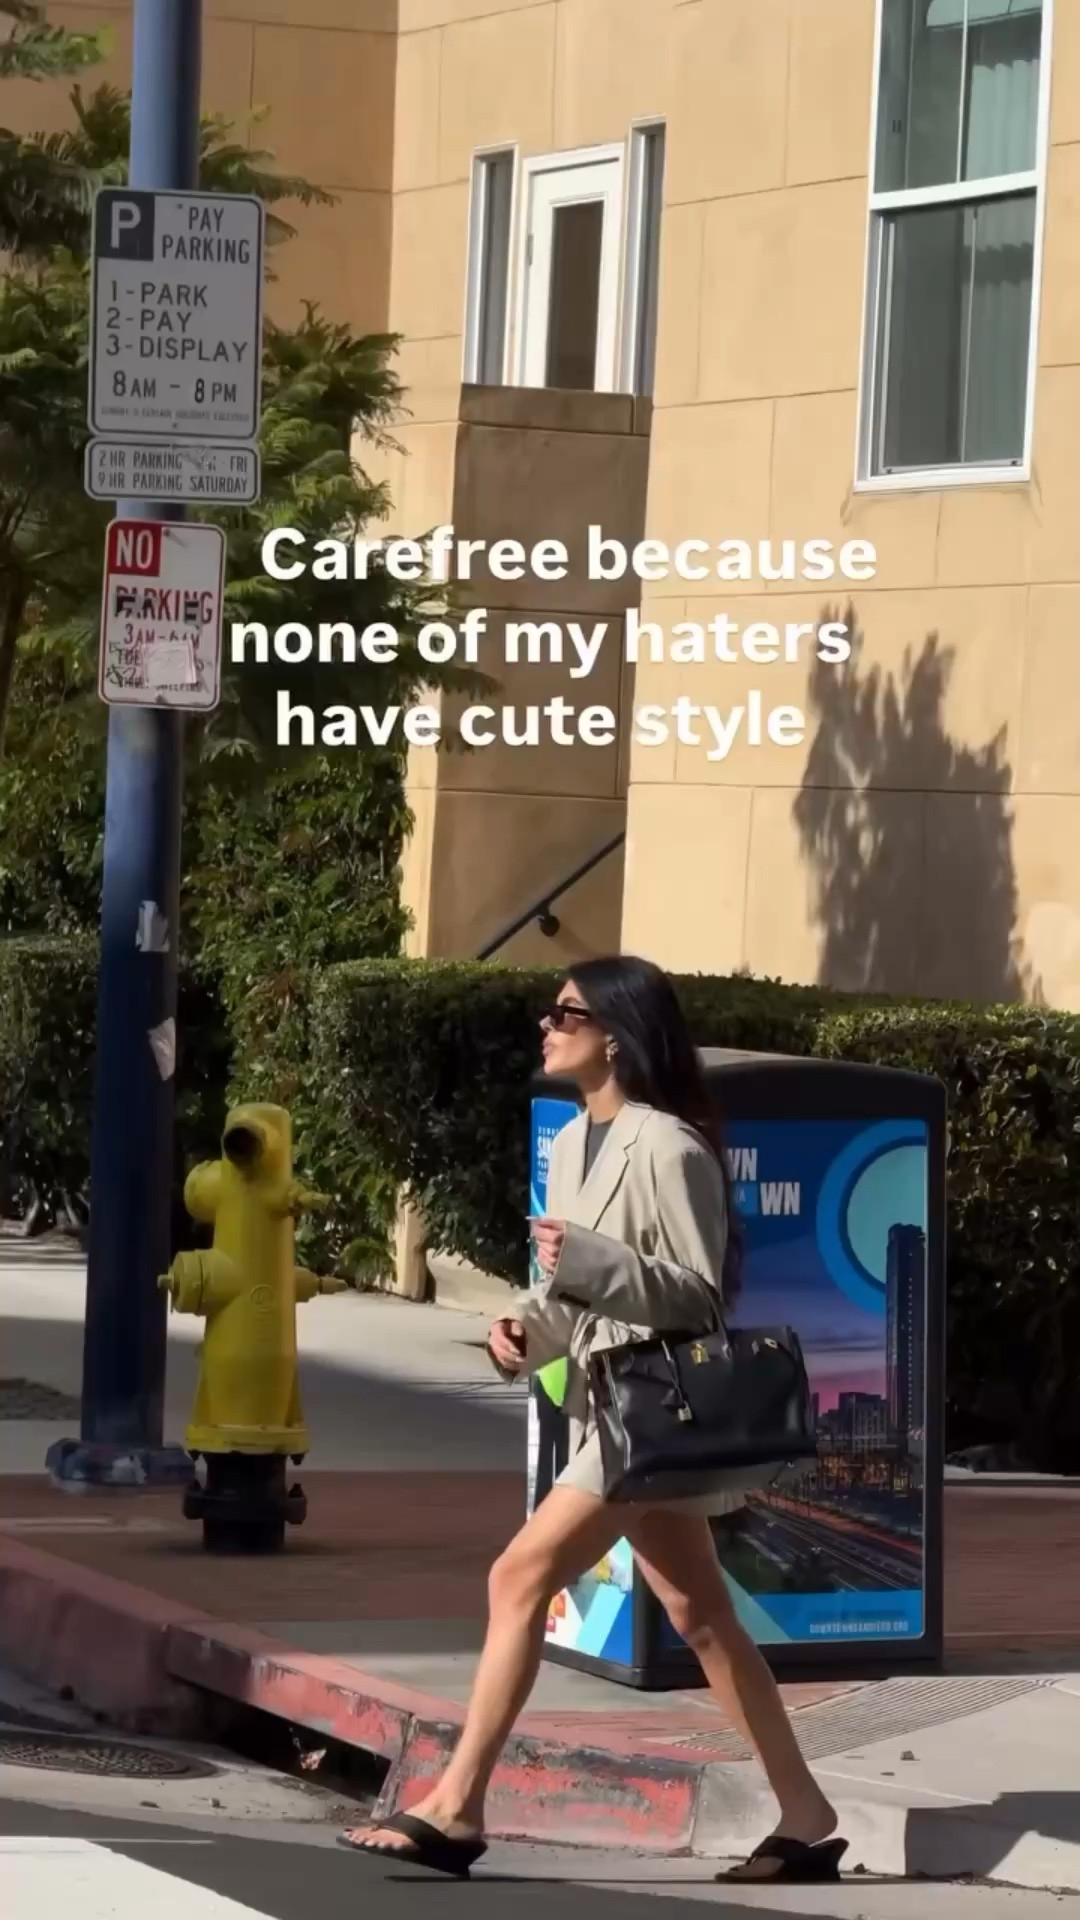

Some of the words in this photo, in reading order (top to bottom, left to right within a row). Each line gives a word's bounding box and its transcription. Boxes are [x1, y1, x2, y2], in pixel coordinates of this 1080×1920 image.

[110, 200, 141, 249] P
[188, 206, 224, 233] PAY
[161, 234, 250, 264] PARKING
[133, 451, 183, 470] PARKING
[132, 471, 183, 492] PARKING
[189, 475, 249, 493] SATURDAY
[116, 528, 154, 570] NO
[760, 1182, 800, 1215] WN
